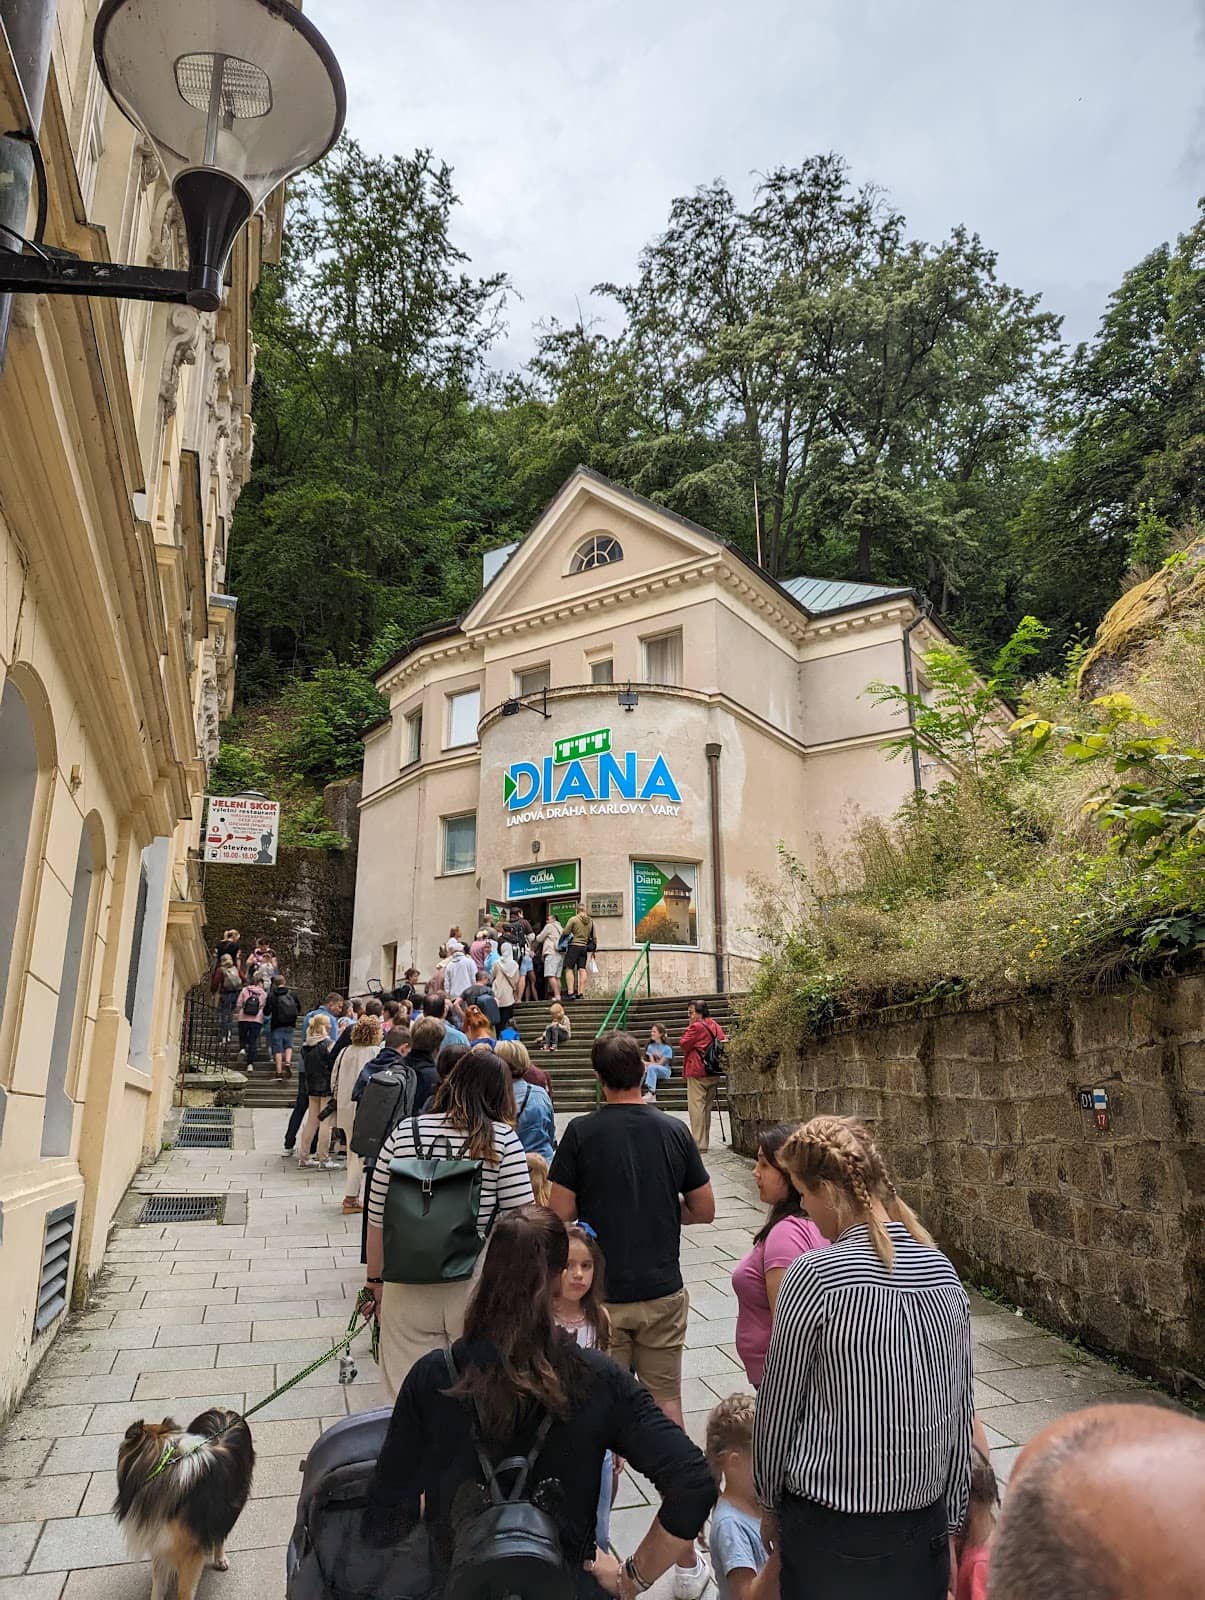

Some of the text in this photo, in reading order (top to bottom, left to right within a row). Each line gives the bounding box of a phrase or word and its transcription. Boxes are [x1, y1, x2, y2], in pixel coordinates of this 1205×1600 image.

[508, 750, 684, 811] DIANA
[212, 800, 278, 811] JELENÍ SKOK
[506, 803, 681, 828] LANOVÁ DRÁHA KARLOVY VARY
[636, 875, 662, 885] Diana
